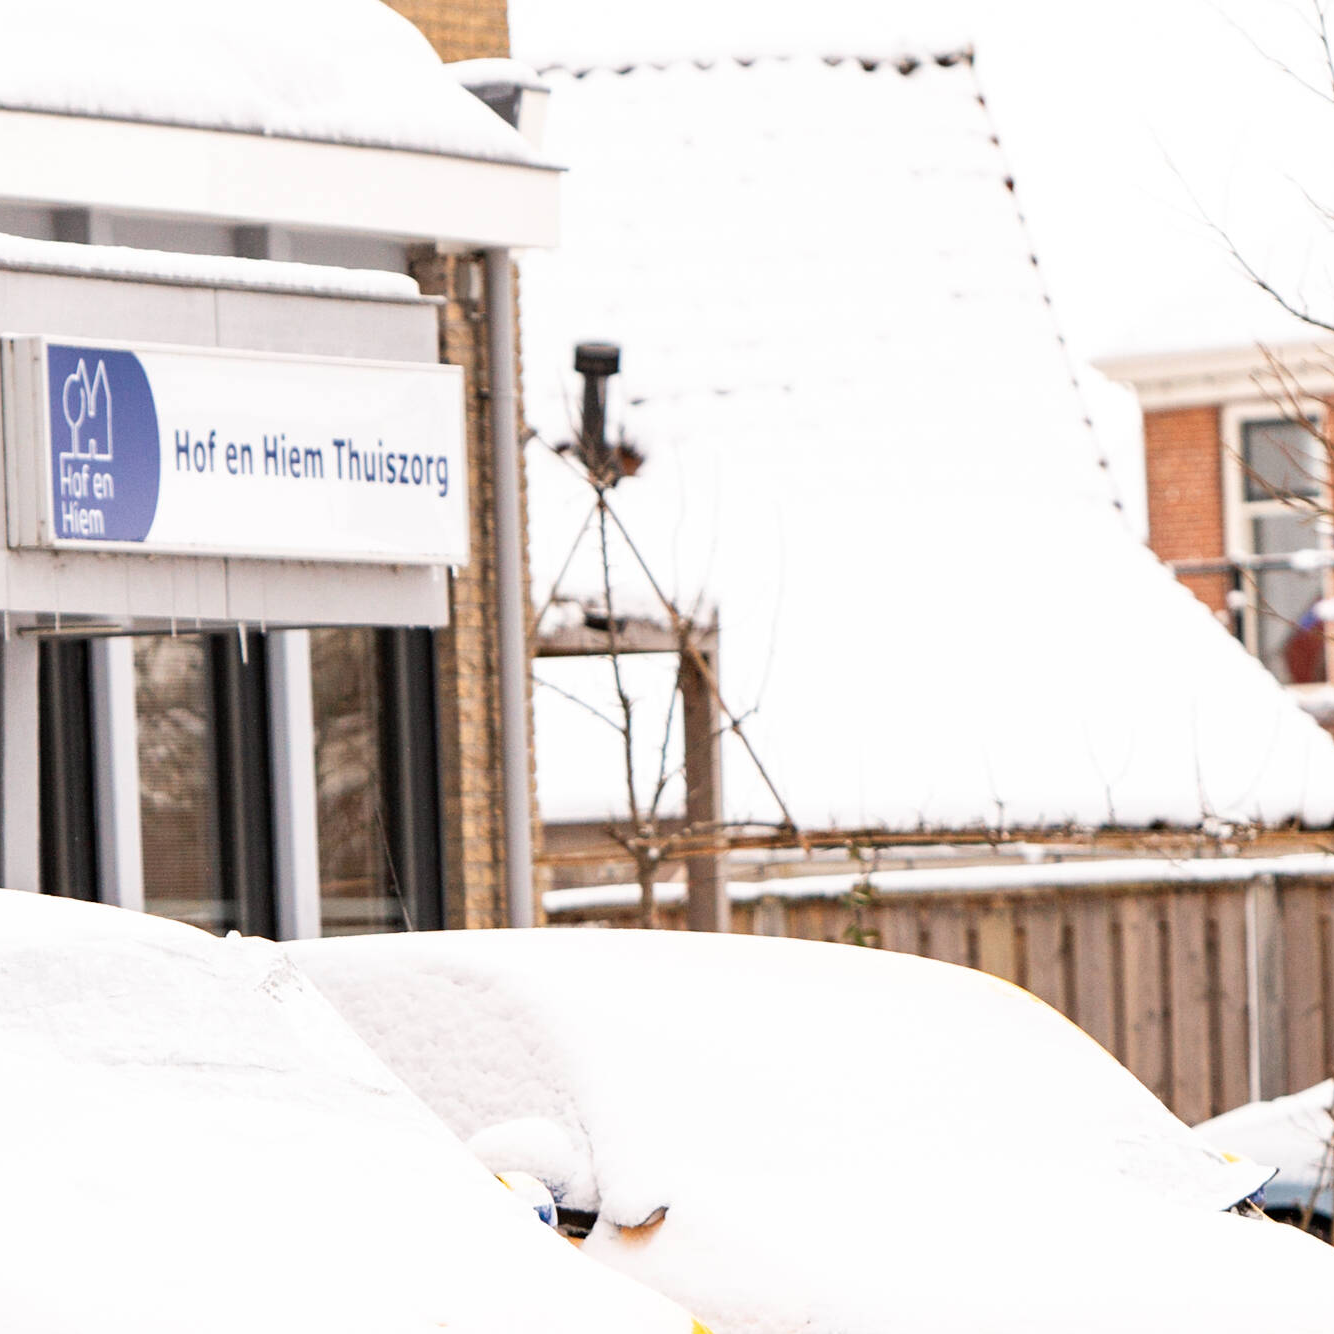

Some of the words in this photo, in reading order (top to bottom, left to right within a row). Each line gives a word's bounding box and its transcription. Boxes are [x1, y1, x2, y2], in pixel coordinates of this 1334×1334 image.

[59, 463, 90, 499] Hof
[92, 471, 115, 499] en
[174, 428, 216, 473] Hof
[225, 439, 255, 475] en
[263, 433, 324, 479] Hiem
[333, 438, 450, 498] Thuiszorg
[61, 500, 105, 535] Hiem
